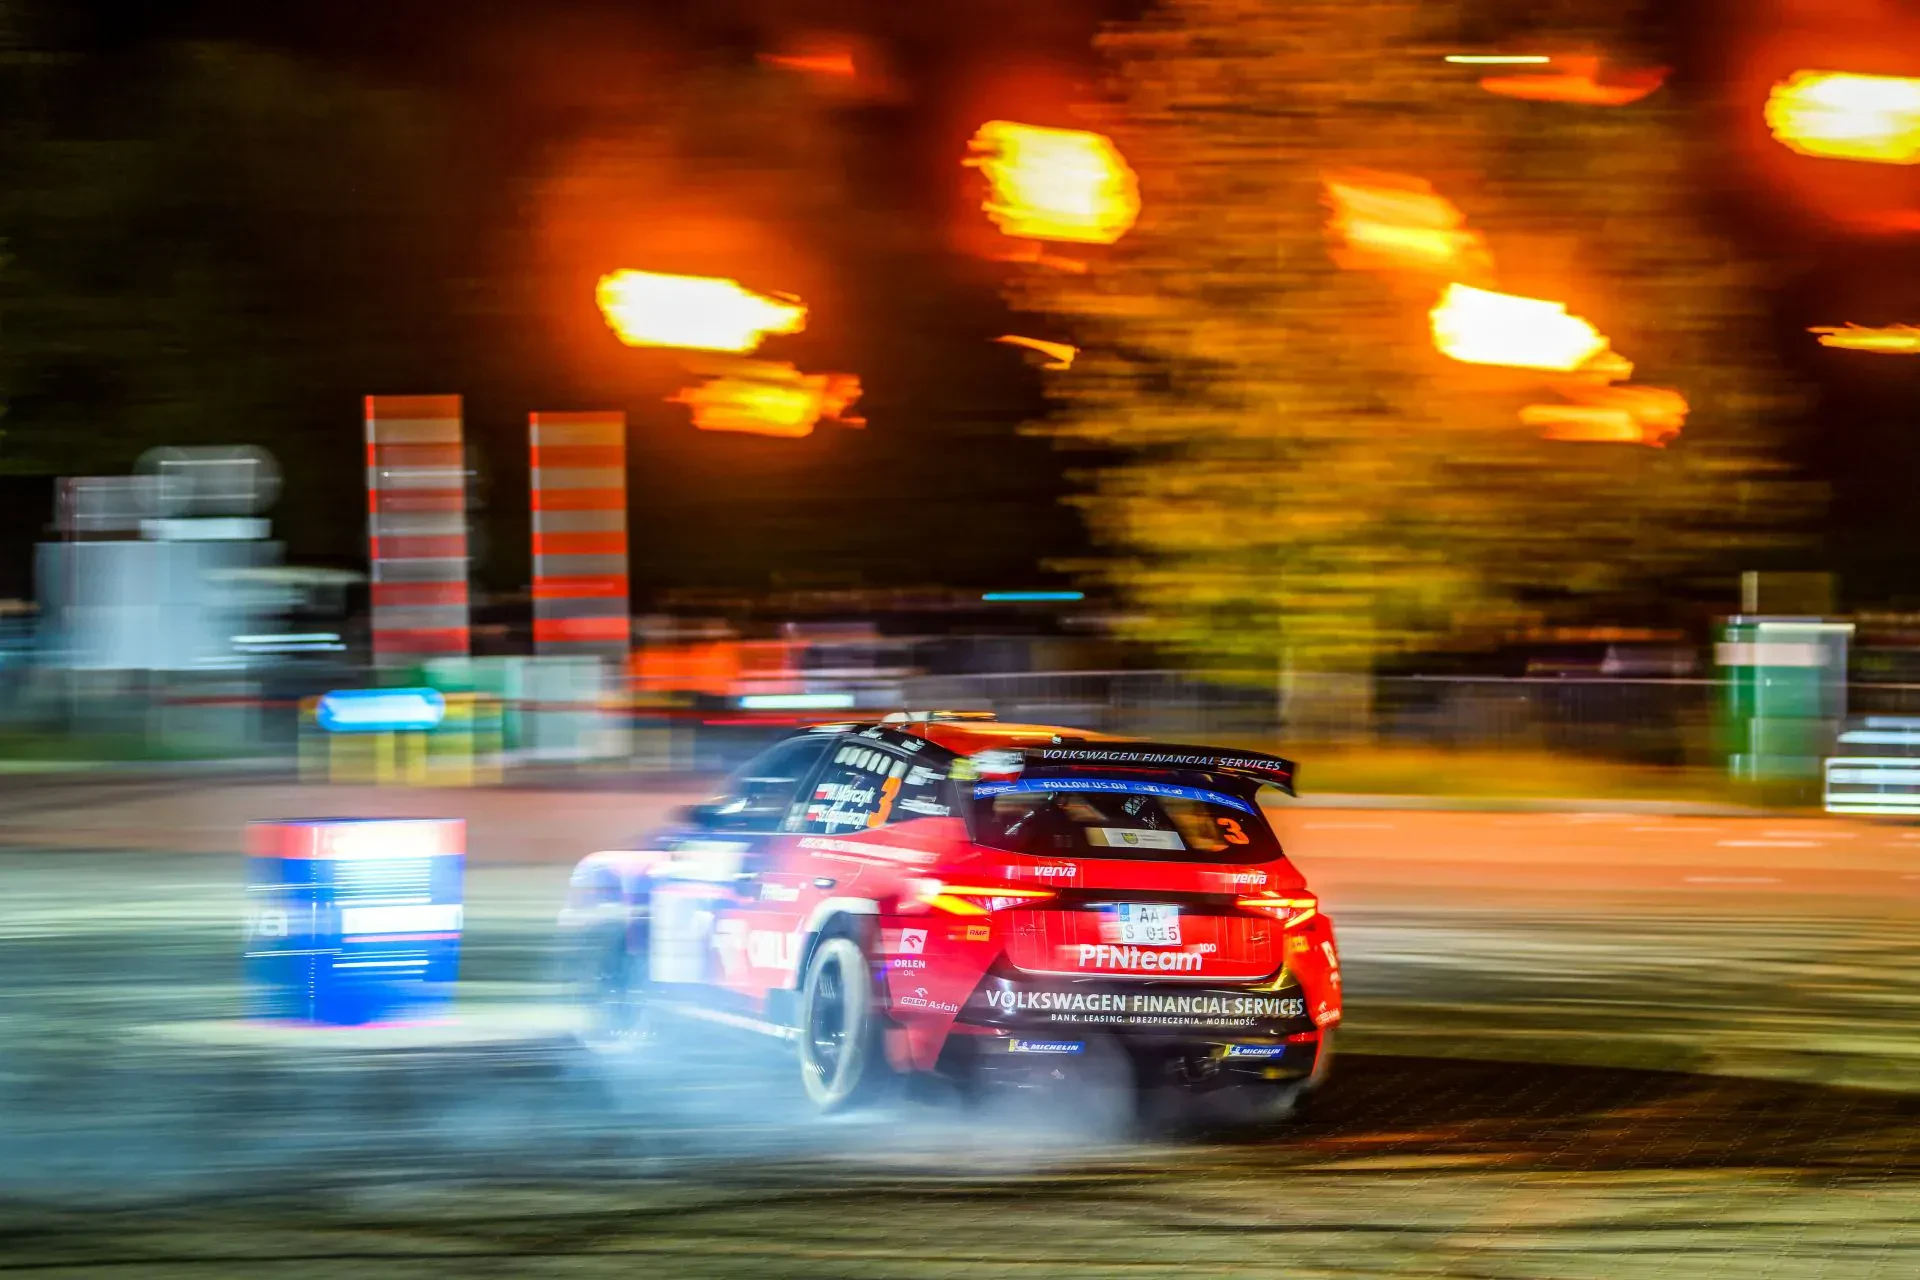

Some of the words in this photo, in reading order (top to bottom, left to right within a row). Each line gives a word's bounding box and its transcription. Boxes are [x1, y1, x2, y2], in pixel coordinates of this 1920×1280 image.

[1043, 749, 1139, 761] VOLKSWAGEN
[1142, 753, 1214, 765] FINANCIAL
[1218, 757, 1282, 771] SERVICES
[1043, 781, 1089, 789] FOLLOW
[1112, 782, 1128, 790] ON
[867, 776, 901, 828] 3
[1217, 817, 1249, 844] 3
[1034, 865, 1077, 877] verva
[1232, 873, 1267, 884] verva
[1125, 924, 1135, 940] S
[1078, 943, 1203, 971] PFNteam
[1200, 943, 1217, 953] 100
[895, 959, 926, 969] ORLEN
[928, 1001, 959, 1013] Asfalt
[986, 989, 1126, 1012] VOLKSWAGEN
[1133, 995, 1230, 1014] FINANCIAL
[1234, 998, 1304, 1015] SERVICES
[1051, 1013, 1080, 1022] BANK.
[1084, 1014, 1126, 1023] LEASING.
[1129, 1016, 1203, 1025] UBEZPIECZENIA.
[1206, 1017, 1258, 1026] MOBILNOŚĆ.
[1030, 1043, 1079, 1051] MICHELIN
